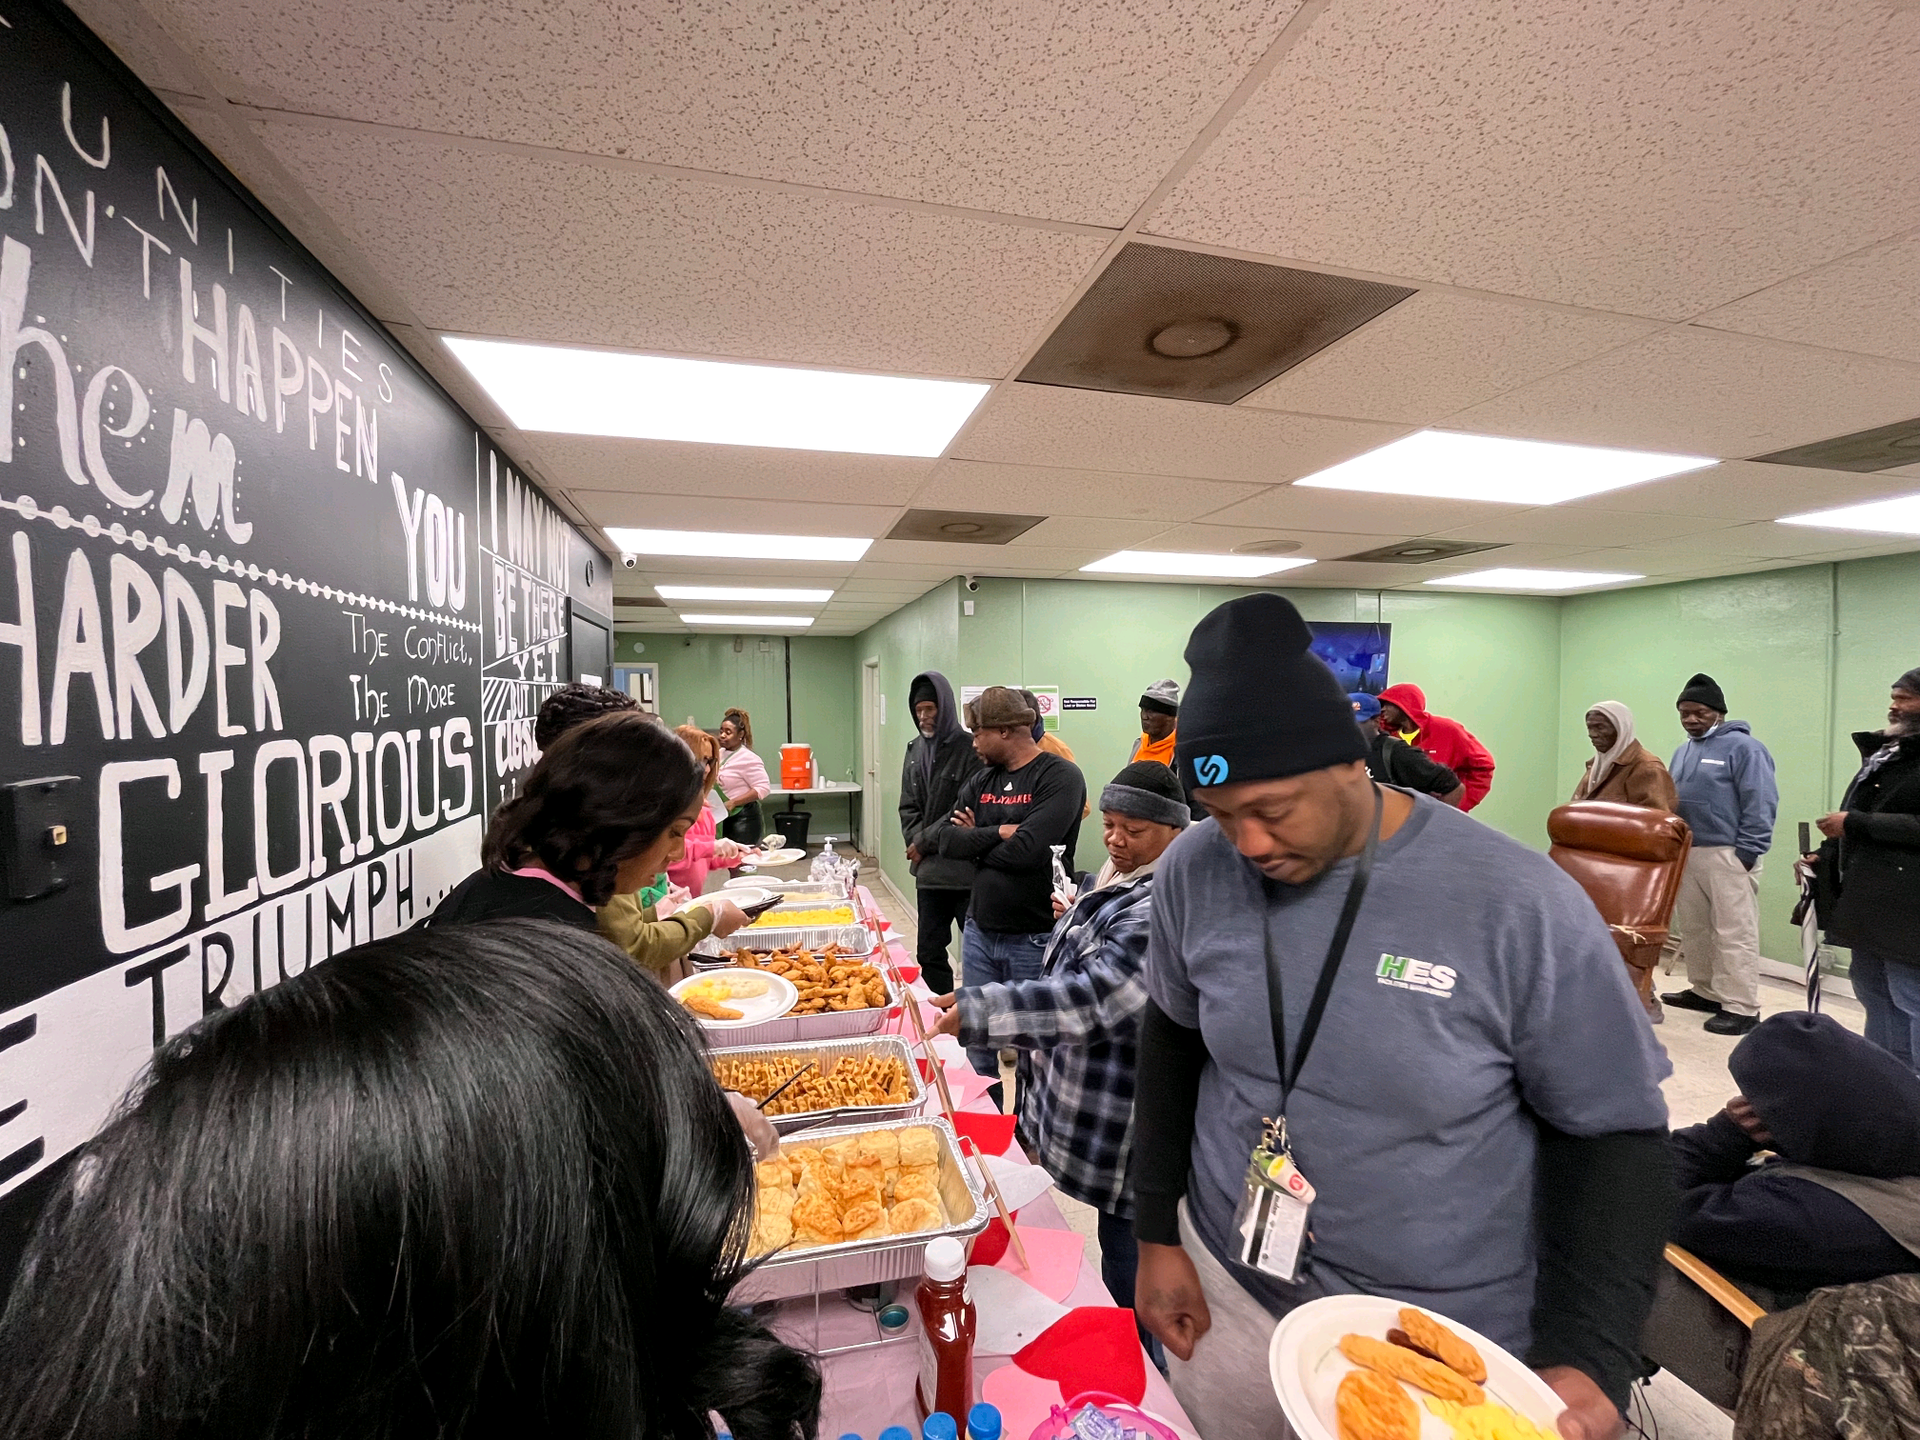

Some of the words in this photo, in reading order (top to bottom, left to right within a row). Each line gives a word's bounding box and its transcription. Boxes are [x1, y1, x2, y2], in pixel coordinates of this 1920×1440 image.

[180, 257, 378, 484] HAPPEN
[391, 472, 466, 613] YOU
[490, 449, 498, 554] I
[506, 467, 543, 576] MAY
[546, 505, 571, 594] NOT
[0, 531, 283, 746] HARDER
[493, 557, 517, 659] BE
[520, 573, 565, 649] THERE
[512, 640, 560, 682] YET
[510, 682, 530, 720] BUT
[99, 717, 473, 954] GLORIOUS
[1375, 953, 1457, 990] HES
